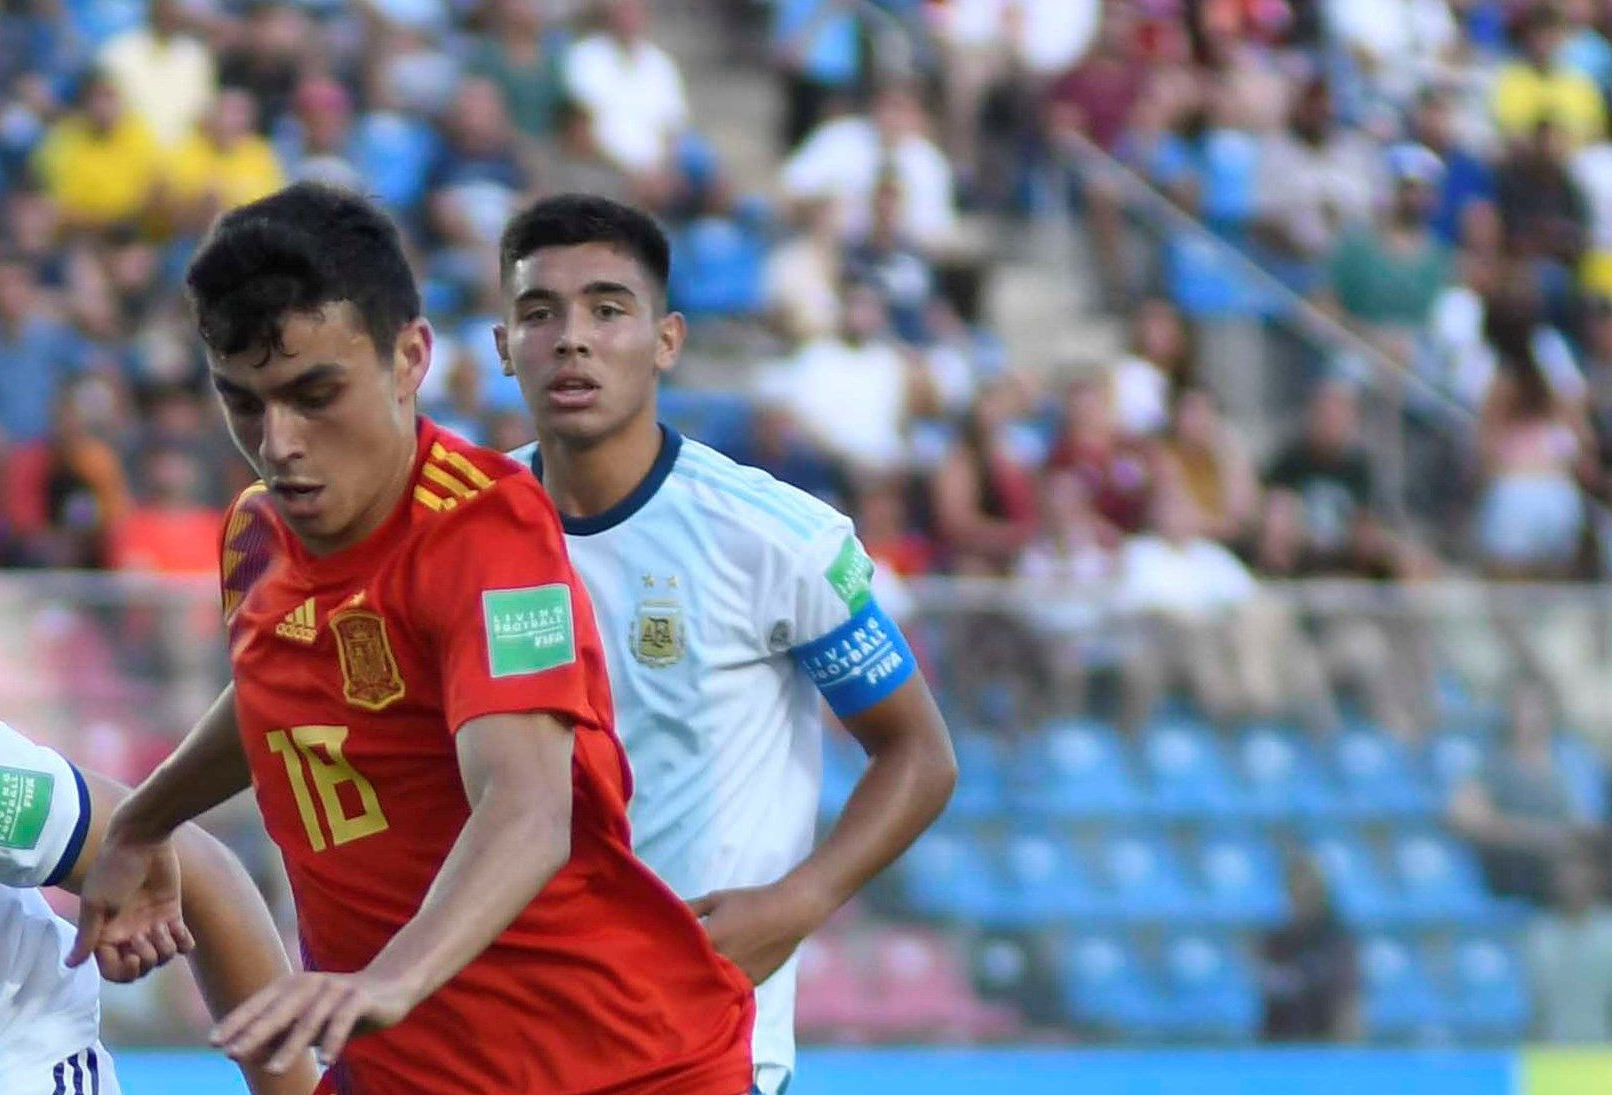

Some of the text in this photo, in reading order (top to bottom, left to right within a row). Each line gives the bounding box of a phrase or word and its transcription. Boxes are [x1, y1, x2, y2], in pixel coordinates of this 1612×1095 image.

[801, 615, 880, 670] LIVING
[866, 650, 904, 686] FIFA
[267, 724, 389, 852] 18
